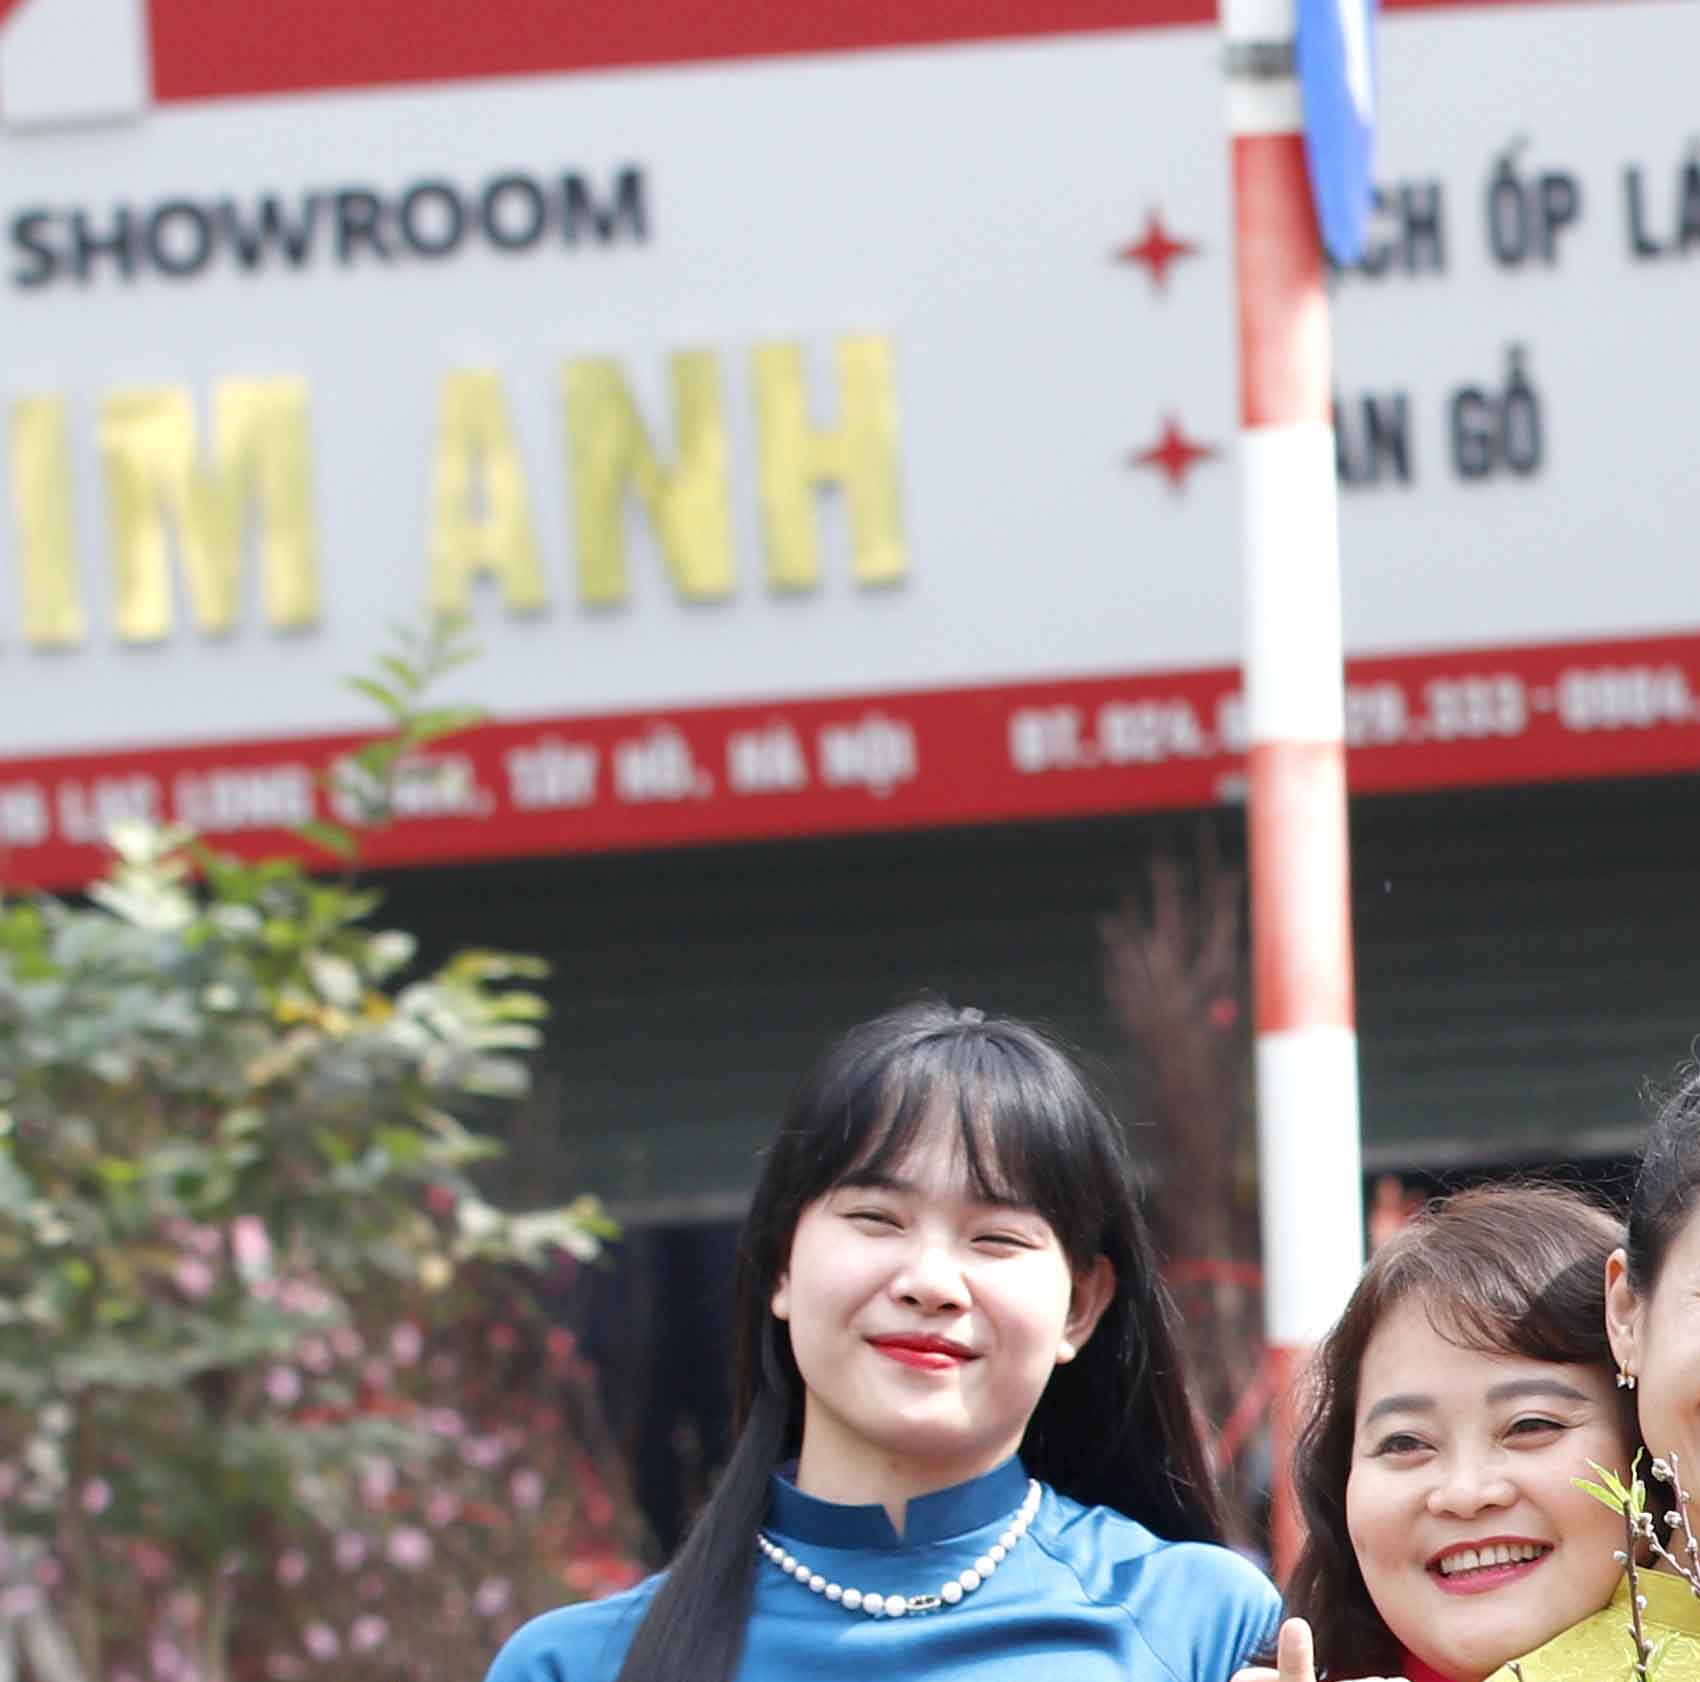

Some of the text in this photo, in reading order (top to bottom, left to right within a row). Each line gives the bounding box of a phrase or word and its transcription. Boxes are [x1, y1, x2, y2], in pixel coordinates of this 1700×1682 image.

[10, 166, 648, 291] SHOWROOM
[1486, 138, 1582, 270] ỐP
[1450, 342, 1544, 484] GỖ
[0, 333, 908, 648] IM ANH
